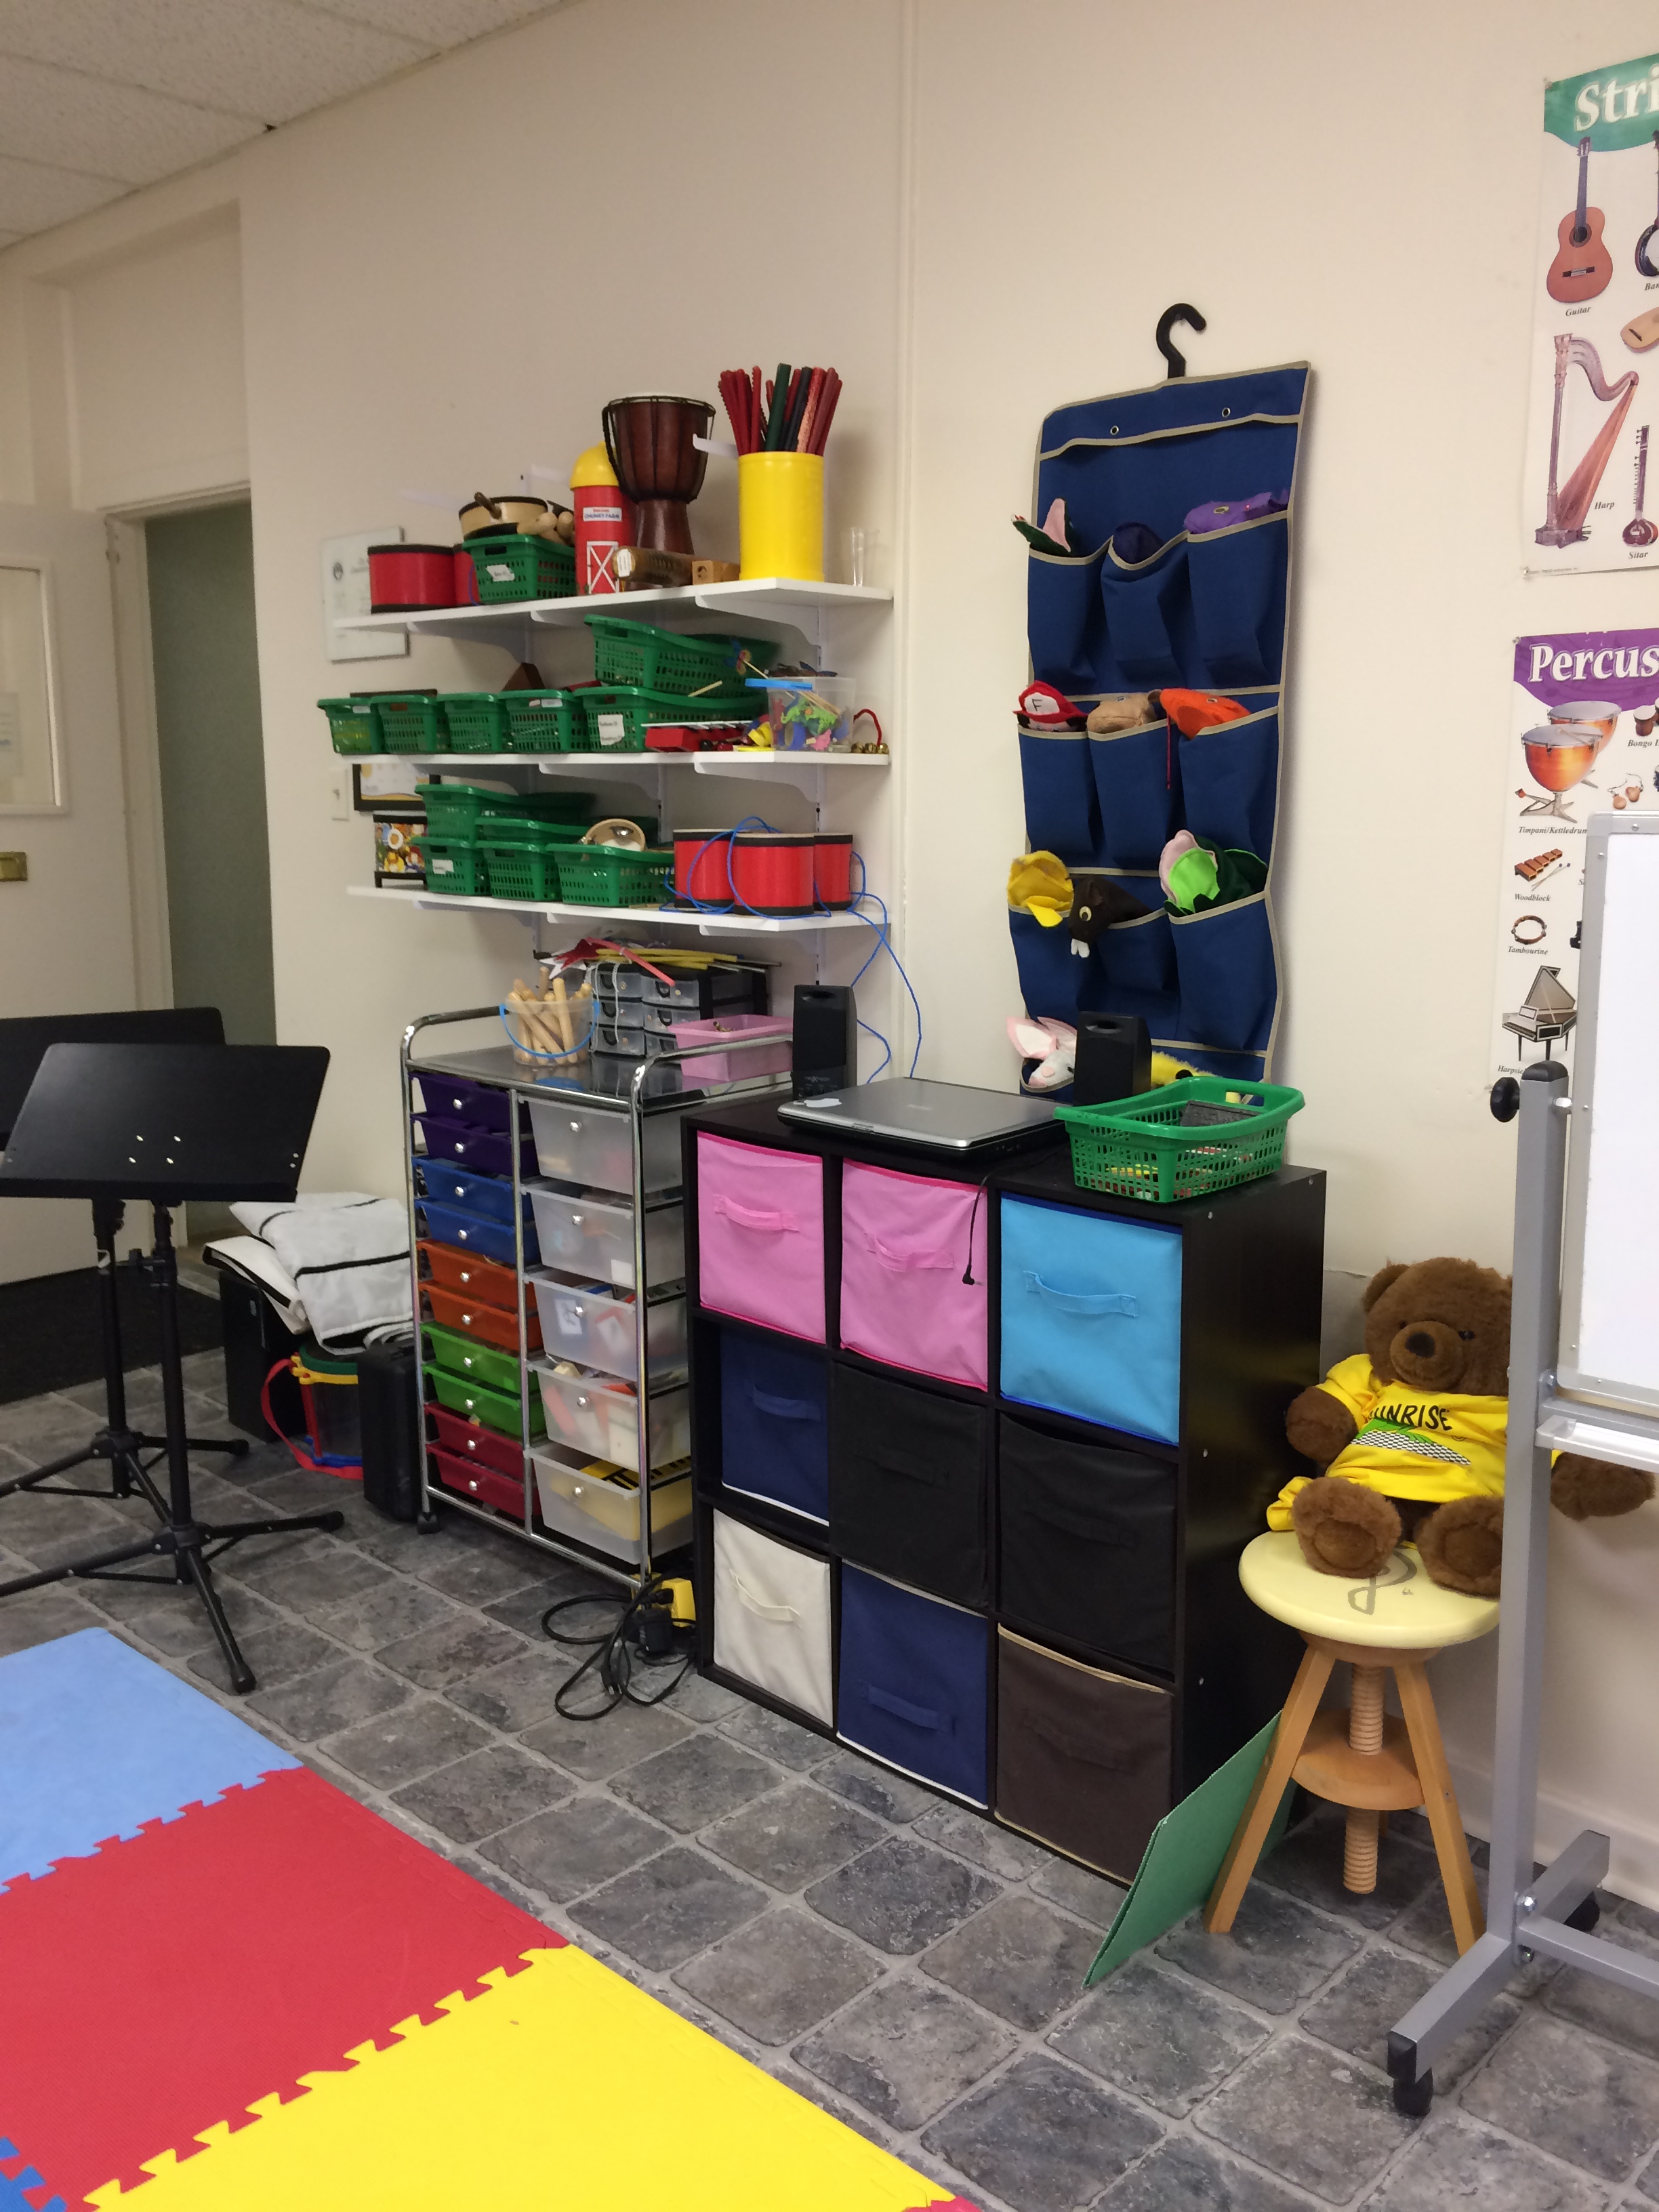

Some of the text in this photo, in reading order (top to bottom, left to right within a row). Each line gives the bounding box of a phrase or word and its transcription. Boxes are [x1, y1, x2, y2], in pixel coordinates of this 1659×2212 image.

[1565, 306, 1591, 316] Guitar
[1594, 501, 1615, 510] Harp
[1628, 551, 1648, 560] Sitar
[1528, 644, 1659, 682] Percus
[1031, 699, 1042, 712] F
[1627, 739, 1652, 748] Bongo
[1515, 893, 1551, 902] Woodblock
[1508, 946, 1549, 956] Tambourine
[1498, 1065, 1525, 1075] Harpsic
